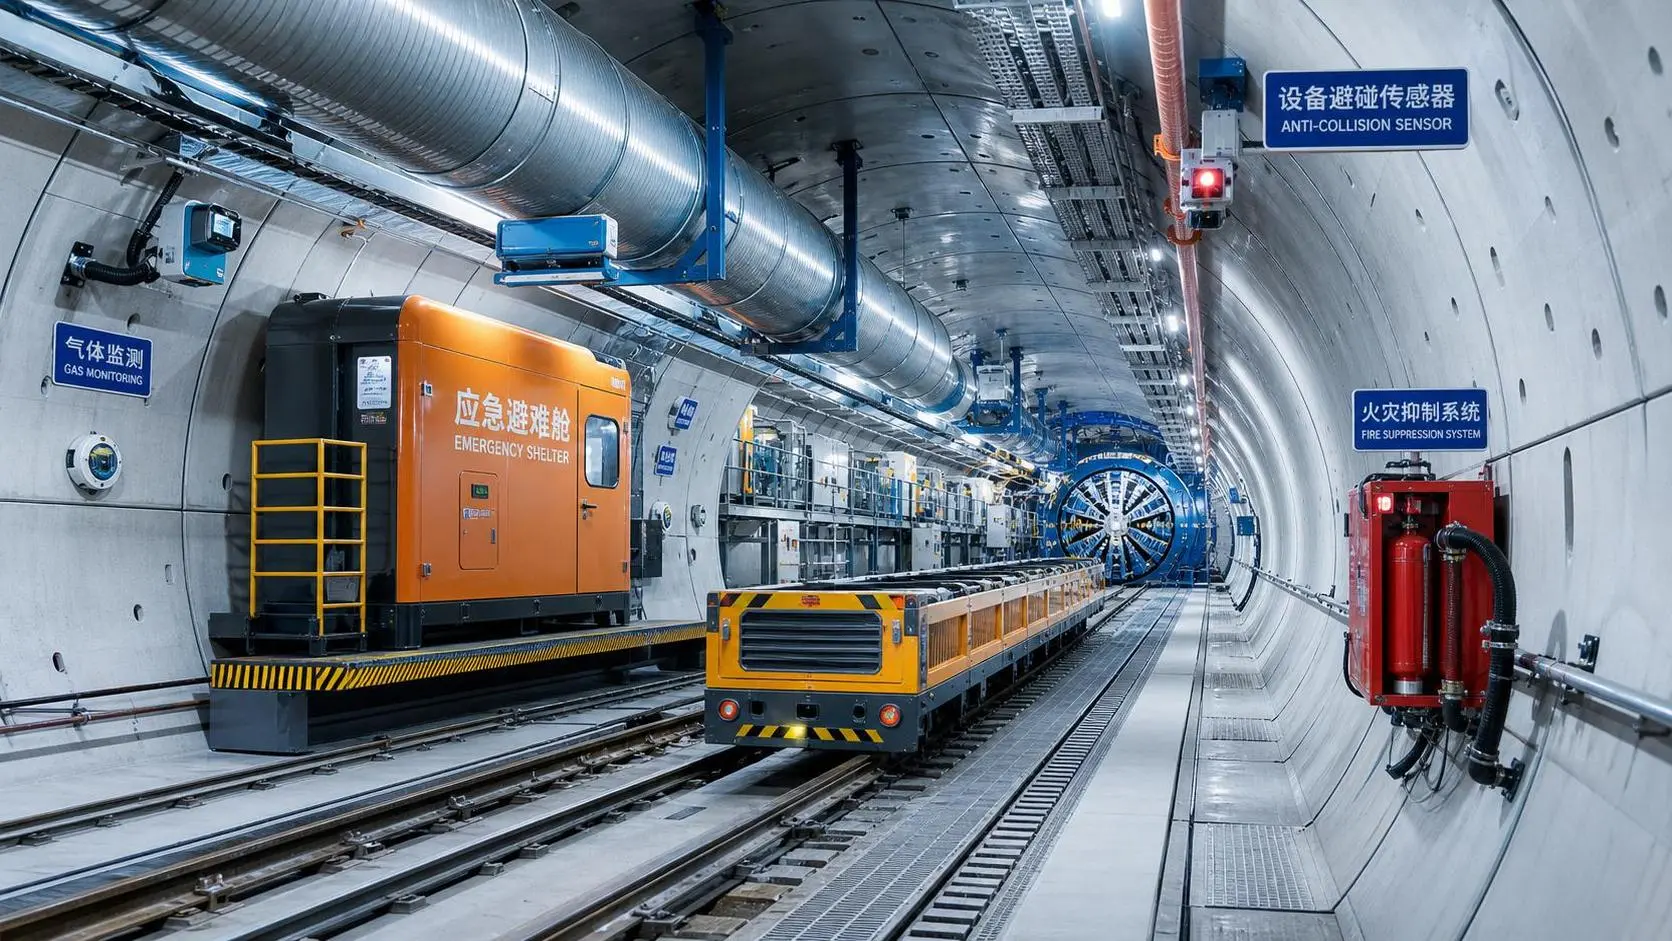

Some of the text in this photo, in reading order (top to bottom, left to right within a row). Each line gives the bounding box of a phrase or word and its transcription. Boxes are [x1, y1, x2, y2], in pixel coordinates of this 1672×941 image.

[1278, 83, 1455, 111] 设备避碰传感器
[1281, 117, 1452, 133] ANTI-COLLISION SENSOR
[65, 336, 144, 370] 气体监测
[64, 363, 143, 385] GAS MONITORING
[454, 387, 571, 443] 应急避难舱
[1361, 401, 1481, 423] 火灾抑制系统
[1361, 429, 1481, 440] FIRE SUPPRESSION SYSTEM
[454, 434, 570, 465] EMERGENCY SHELTER
